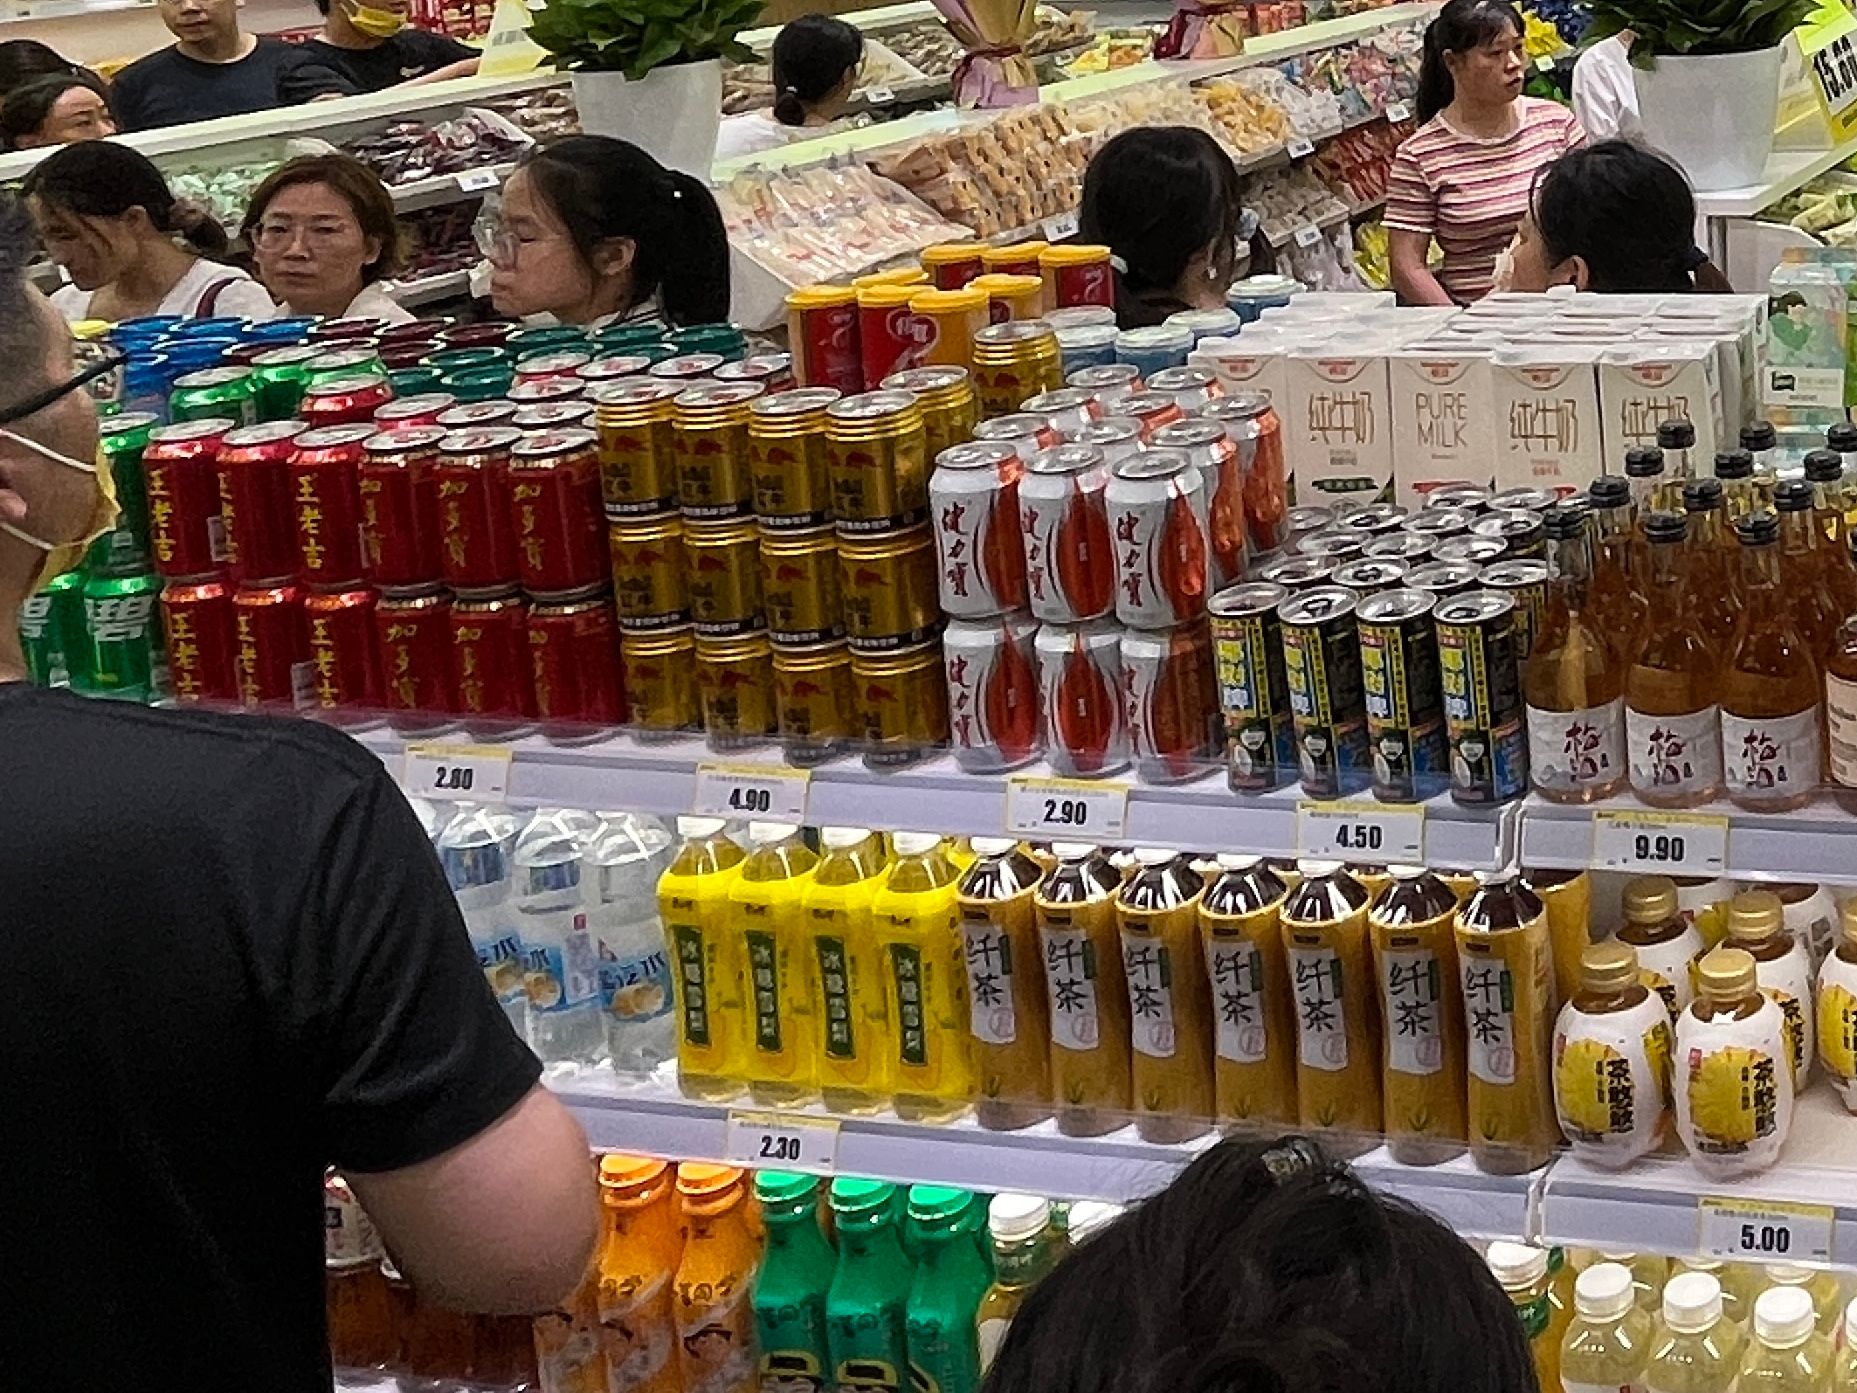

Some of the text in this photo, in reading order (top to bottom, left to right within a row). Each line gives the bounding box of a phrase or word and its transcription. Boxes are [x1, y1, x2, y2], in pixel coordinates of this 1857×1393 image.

[1307, 390, 1375, 446] 纯牛奶
[1415, 392, 1468, 417] PURE
[1510, 398, 1579, 453] 纯牛奶
[1416, 421, 1469, 449] MILK
[149, 470, 177, 562] 王老吉
[296, 475, 325, 569] 王老吉
[729, 788, 770, 812] 4.90
[1043, 799, 1087, 825] 2.90
[1336, 824, 1383, 850] 4.50
[1635, 834, 1684, 862] 9.90
[967, 933, 1003, 1007] 纤茶
[1048, 939, 1089, 1013] 纤茶
[1127, 946, 1164, 1017] 纤茶
[1215, 951, 1253, 1026] 纤茶
[1296, 959, 1336, 1033] 纤茶
[1389, 960, 1433, 1037] 纤茶
[1465, 966, 1504, 1044] 纤茶
[760, 1135, 800, 1161] 2.30
[1741, 1224, 1791, 1253] 5.00
